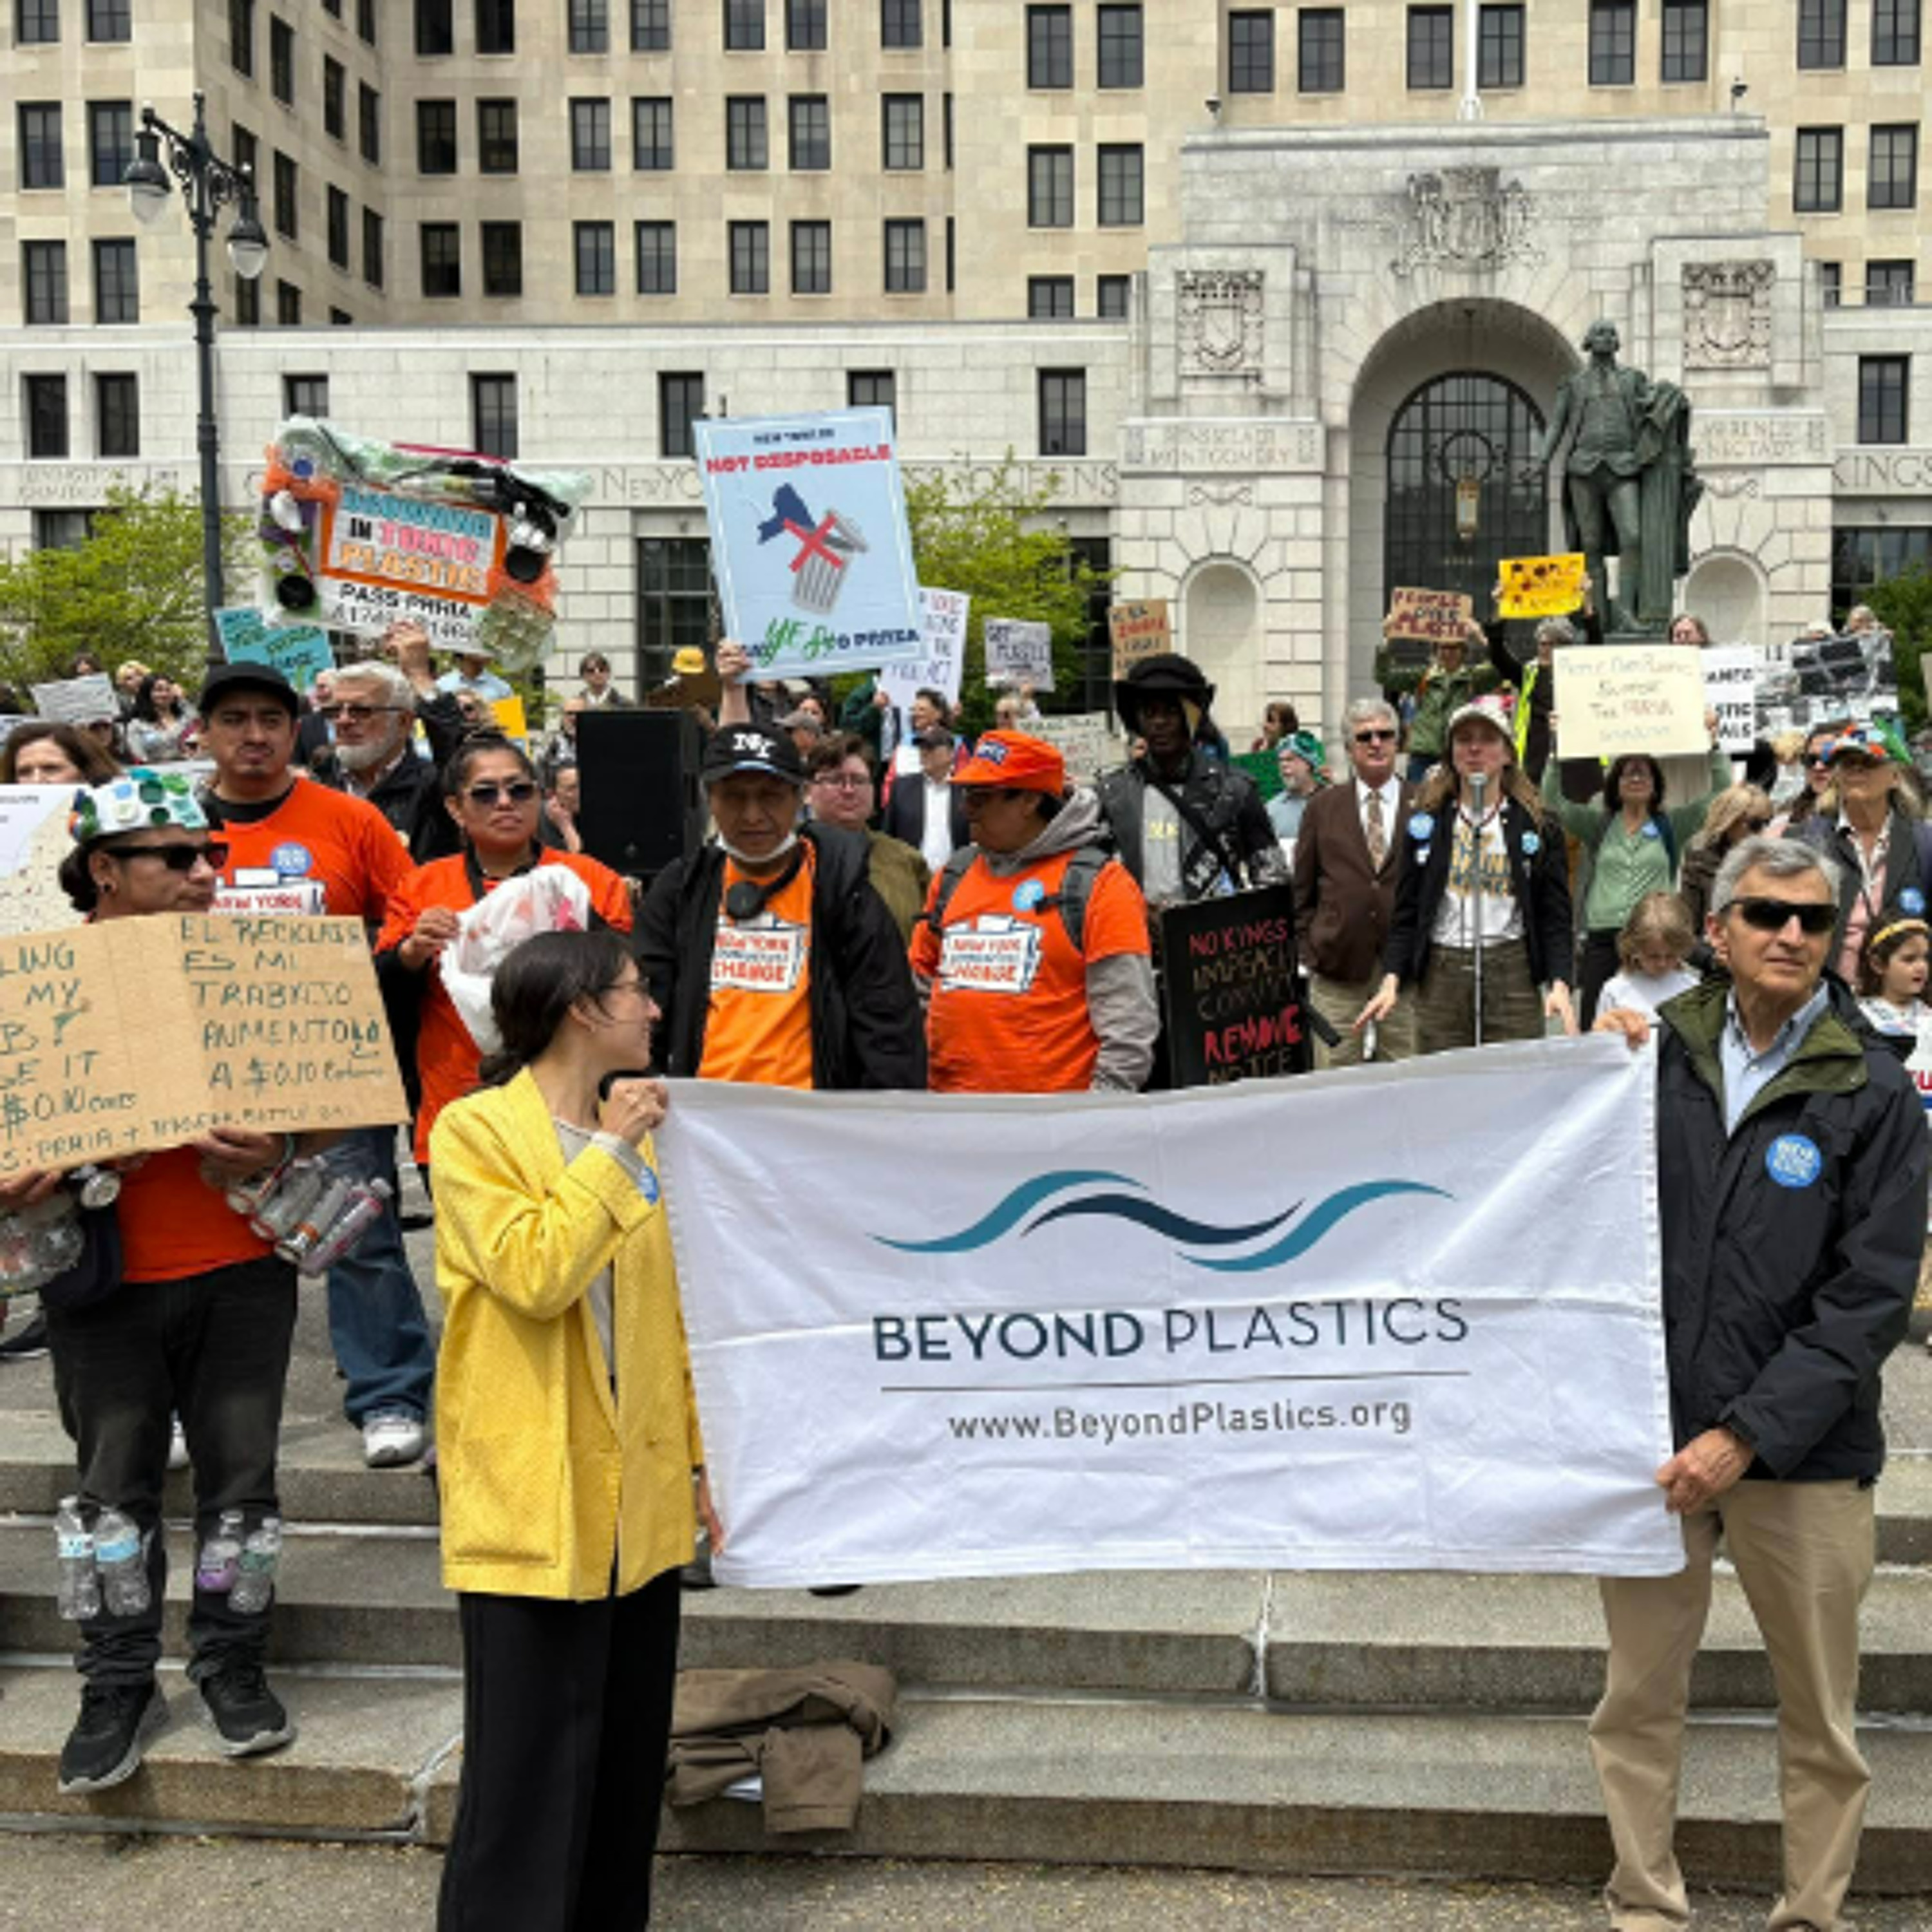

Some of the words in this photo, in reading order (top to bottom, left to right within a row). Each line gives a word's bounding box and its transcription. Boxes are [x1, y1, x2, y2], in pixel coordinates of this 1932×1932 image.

[706, 455, 750, 473] NOT
[350, 517, 373, 541] IN
[339, 543, 483, 591] PLASTIC
[25, 977, 82, 1006] MY
[873, 1312, 1144, 1361] BEYOND
[1164, 1297, 1469, 1353] PLASTICS
[949, 1399, 1412, 1444] www.BeyondPlastics.org
